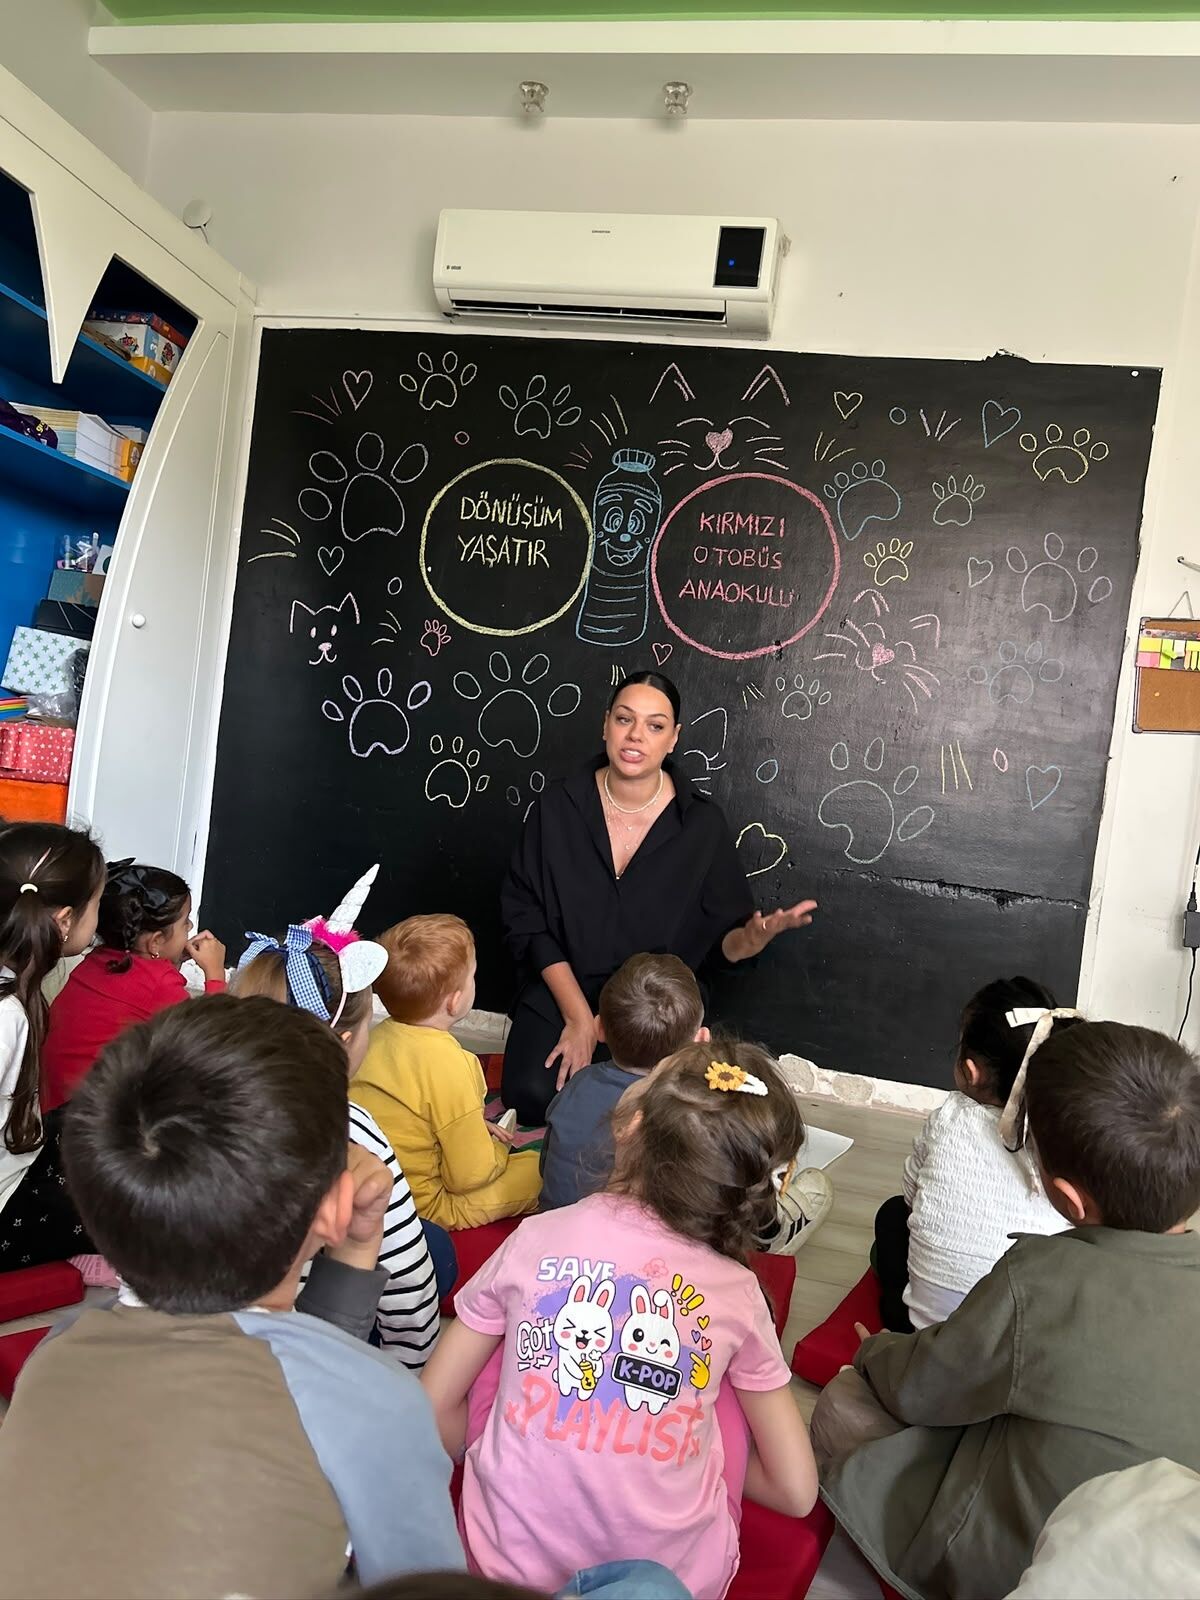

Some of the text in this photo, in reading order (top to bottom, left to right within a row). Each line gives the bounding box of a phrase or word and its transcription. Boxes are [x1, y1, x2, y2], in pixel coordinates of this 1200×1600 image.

[459, 491, 563, 531] DÖNÜŞÜM
[699, 511, 785, 539] KIRMIZI
[457, 534, 550, 569] YAŞATIR
[693, 545, 783, 570] OTOBÜS
[678, 578, 794, 608] ANAOKULU
[537, 1256, 616, 1283] SAVE
[619, 1360, 677, 1392] K-POP
[522, 1374, 704, 1468] PLAYLIST
